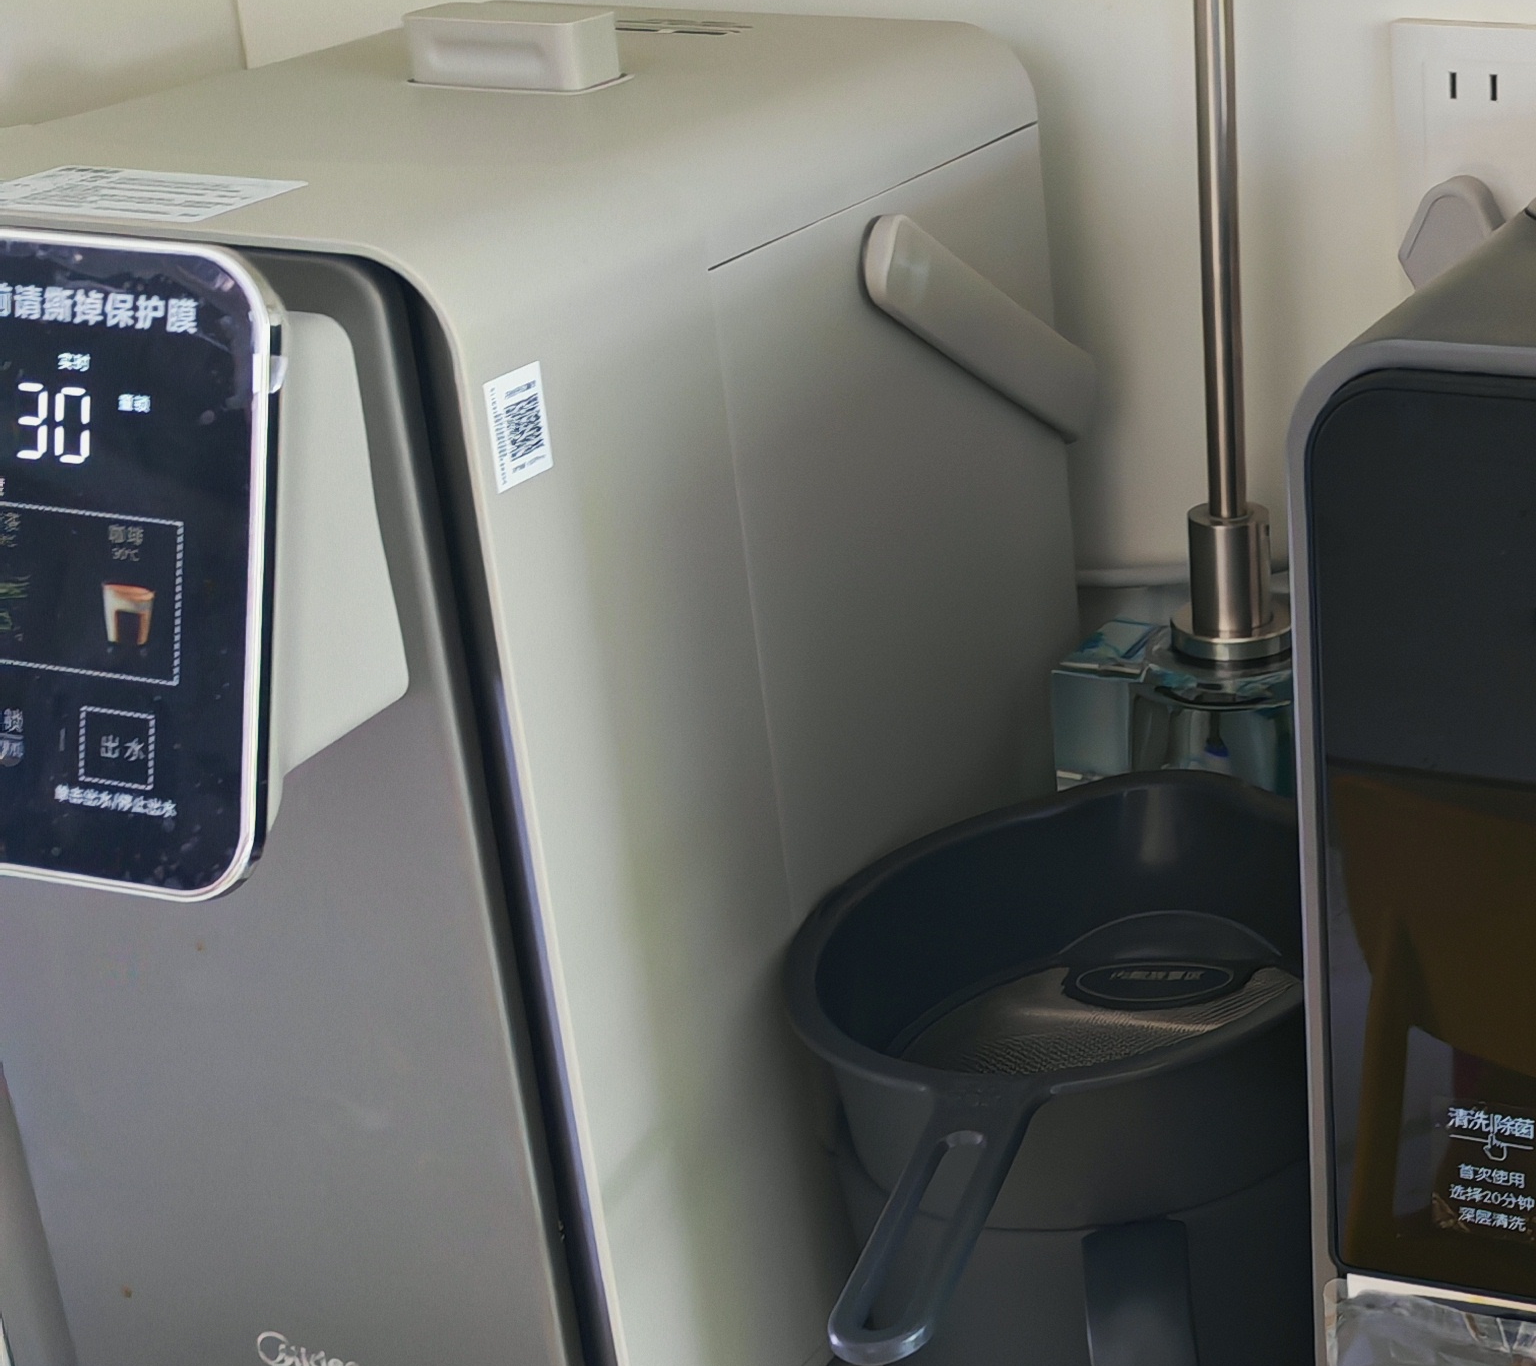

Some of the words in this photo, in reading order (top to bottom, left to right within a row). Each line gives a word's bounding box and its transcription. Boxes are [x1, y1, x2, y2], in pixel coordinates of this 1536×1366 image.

[17, 382, 91, 464] 30
[100, 735, 146, 762] 出水
[1457, 1163, 1526, 1189] 首次使用
[1448, 1183, 1536, 1212] 选择20分钟
[1457, 1206, 1528, 1232] 深层清洗
